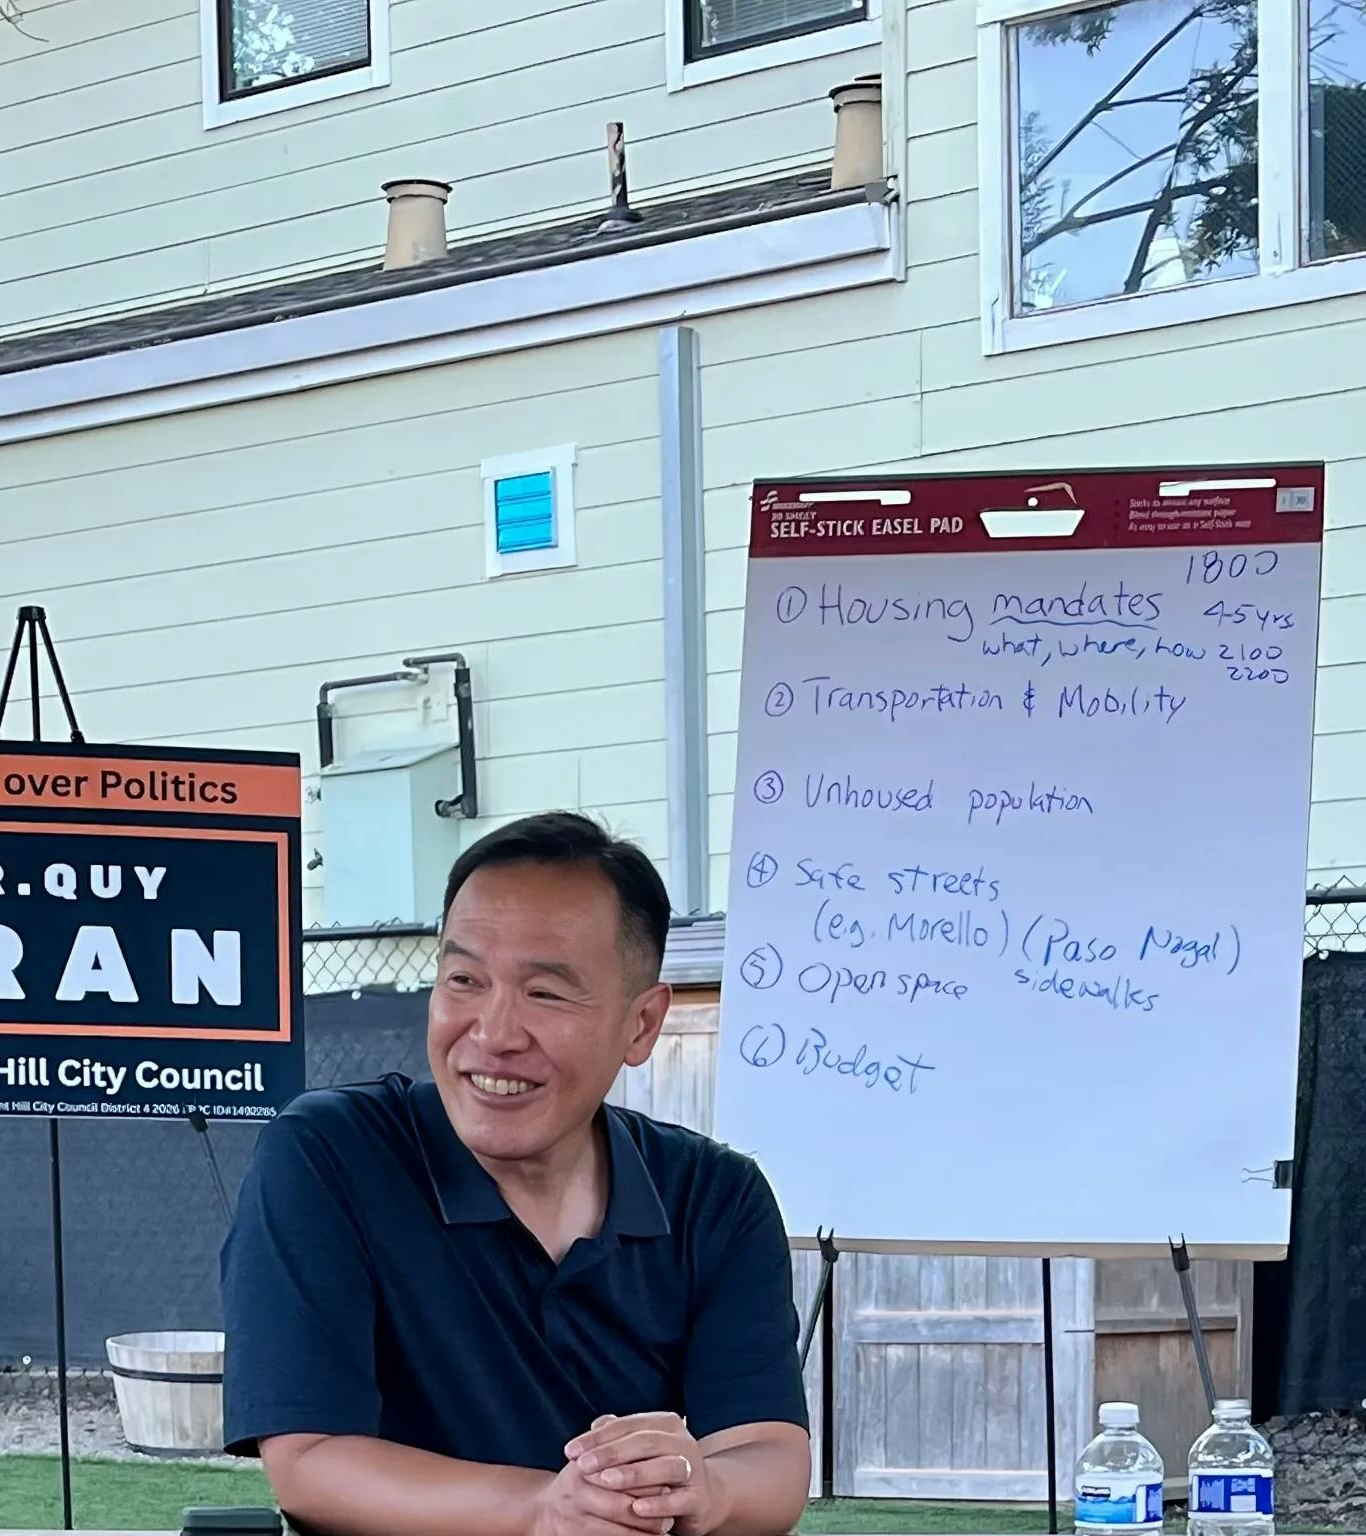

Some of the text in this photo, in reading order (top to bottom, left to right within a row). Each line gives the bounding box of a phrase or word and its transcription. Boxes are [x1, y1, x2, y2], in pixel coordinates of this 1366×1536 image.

[770, 517, 963, 538] SELF-STICK EASEL PAD
[1186, 550, 1278, 584] 1800
[819, 583, 974, 642] Housing
[991, 580, 1163, 621] mandates
[1155, 634, 1206, 660] how
[1218, 644, 1284, 661] 2100
[1226, 666, 1290, 685] 2200
[802, 676, 1003, 722] Transportation
[1058, 683, 1187, 724] Mobility
[3, 771, 89, 797] over
[100, 770, 238, 805] Politics
[806, 773, 934, 812] Unhoused
[967, 781, 1094, 826] population
[795, 857, 866, 891] Safe
[887, 864, 1000, 902] streets
[1022, 914, 1118, 967] (Paso
[797, 961, 887, 1004] Open
[896, 971, 969, 1003] space
[1014, 968, 1160, 1012] sidewalks
[57, 1059, 127, 1096] City
[135, 1061, 264, 1093] Council
[795, 1027, 936, 1094] Budget
[32, 1101, 55, 1114] City
[56, 1101, 98, 1112] Council
[101, 1102, 141, 1113] District
